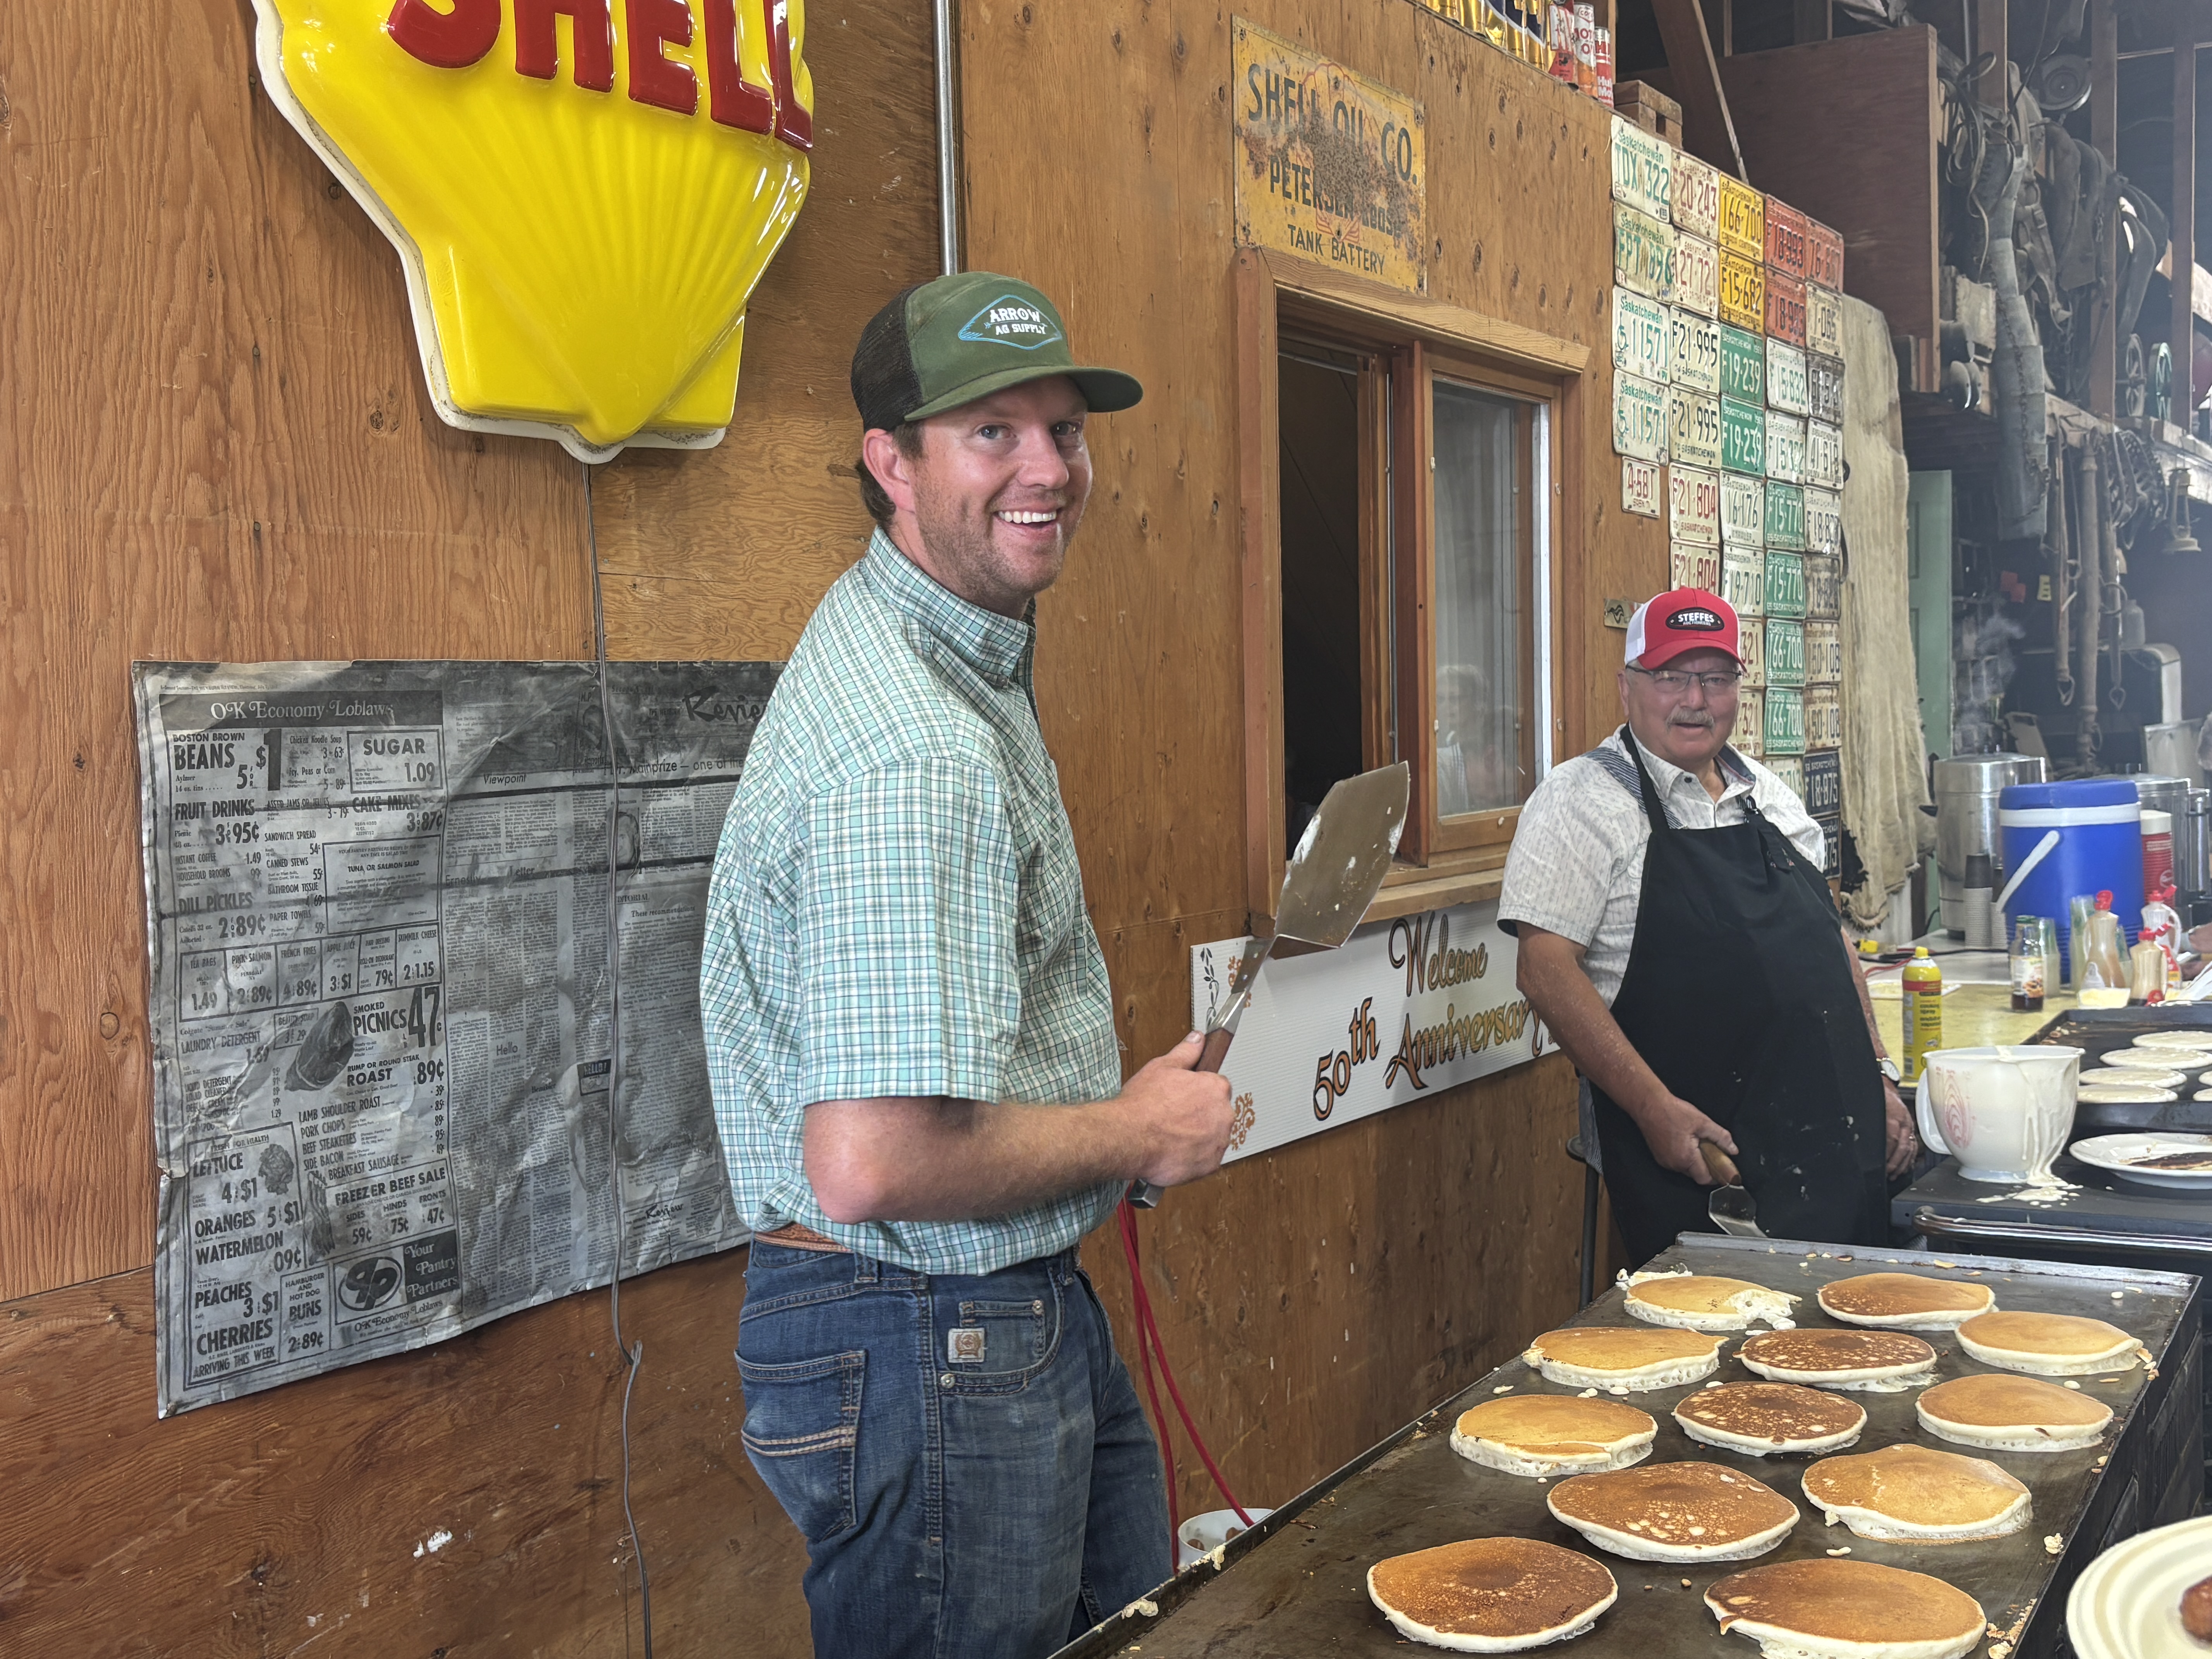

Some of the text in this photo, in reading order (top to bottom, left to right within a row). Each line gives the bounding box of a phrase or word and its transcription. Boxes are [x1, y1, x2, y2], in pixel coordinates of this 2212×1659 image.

[1618, 131, 1664, 164] Saskatchewan
[1614, 142, 1638, 192] TDX
[1645, 158, 1670, 206] 322
[1621, 213, 1664, 245] Saskatchewan
[1287, 223, 1385, 275] TANK BATTERY
[1618, 228, 1673, 285] FPT 896
[990, 307, 1041, 323] ARROW
[1620, 295, 1663, 325] Saskatchewan
[996, 323, 1047, 336] AG SUPPLY
[1631, 318, 1668, 368] 11571
[1621, 379, 1662, 407] Saskatchewan
[1632, 402, 1666, 447] 11571
[1723, 406, 1752, 422] SASKATCHEWAN
[1678, 612, 1715, 623] STEFFES
[210, 700, 394, 720] OK Economy Loblaws
[173, 732, 245, 742] BOSTON BROWN
[290, 735, 342, 744] Chicken Noodle Soup
[363, 737, 426, 756] SUGAR
[174, 743, 235, 771] BEANS
[629, 756, 744, 775] Mainprize one of the
[404, 762, 436, 783] 1.09
[483, 774, 527, 786] Viewpoint
[175, 799, 255, 820] FRUIT DRINKS
[352, 793, 421, 813] CAKE MIXES
[264, 830, 316, 842] SANDWICH SPREAD
[266, 857, 309, 869] CANNED STEWS
[377, 862, 403, 870] SALMON
[268, 882, 319, 895] BATHROOM TISSUE
[178, 891, 254, 914] DILL PICKLES
[649, 905, 696, 916] recommendations
[270, 909, 311, 921] PAPER TOWELS
[281, 946, 317, 958] FRENCH FRIES
[1388, 910, 1488, 998] Welcome
[191, 957, 216, 969] TEA BAGS
[375, 969, 393, 987] 79¢
[191, 992, 218, 1011] 1.49
[354, 1001, 385, 1014] SMOKED
[353, 1008, 407, 1036] PICNICS
[181, 1030, 261, 1054] LAUNDRY DETERGENT
[496, 1041, 518, 1056] Hello
[347, 1063, 365, 1072] RUMP
[379, 1058, 401, 1067] ROUND
[402, 1054, 420, 1063] STEAK
[1313, 996, 1544, 1121] 50th Anniversary
[347, 1059, 445, 1087] ROAST 89¢
[299, 1108, 318, 1123] LAMB
[321, 1101, 356, 1119] SHOULDER
[359, 1096, 381, 1109] ROAST
[300, 1124, 319, 1139] PORK
[321, 1118, 346, 1134] CHOPS
[193, 1152, 244, 1178] LETTUCE
[328, 1153, 400, 1181] BREAKFAST SAUSAGE
[221, 1177, 258, 1204] 4 $1
[335, 1166, 446, 1206] FREEZER BEEF SALE
[346, 1189, 447, 1223] SIDES HINDS FRONTS
[195, 1200, 300, 1238] ORANGES 5 $1
[352, 1207, 445, 1245] 59¢ 75¢ 47¢
[195, 1230, 283, 1266] WATERMELON
[405, 1243, 435, 1258] Your
[273, 1247, 301, 1272] 09¢
[416, 1256, 457, 1276] Pantry
[285, 1273, 325, 1288] HAMBURGER
[297, 1283, 312, 1292] AND
[407, 1276, 458, 1297] Partners
[195, 1281, 252, 1309] PEACHES
[305, 1288, 321, 1297] DOG
[243, 1290, 279, 1318] 3 $1
[289, 1299, 321, 1322] BUNS
[196, 1317, 273, 1355] CHERRIES
[194, 1345, 275, 1378] ARRIVING THIS WEEK
